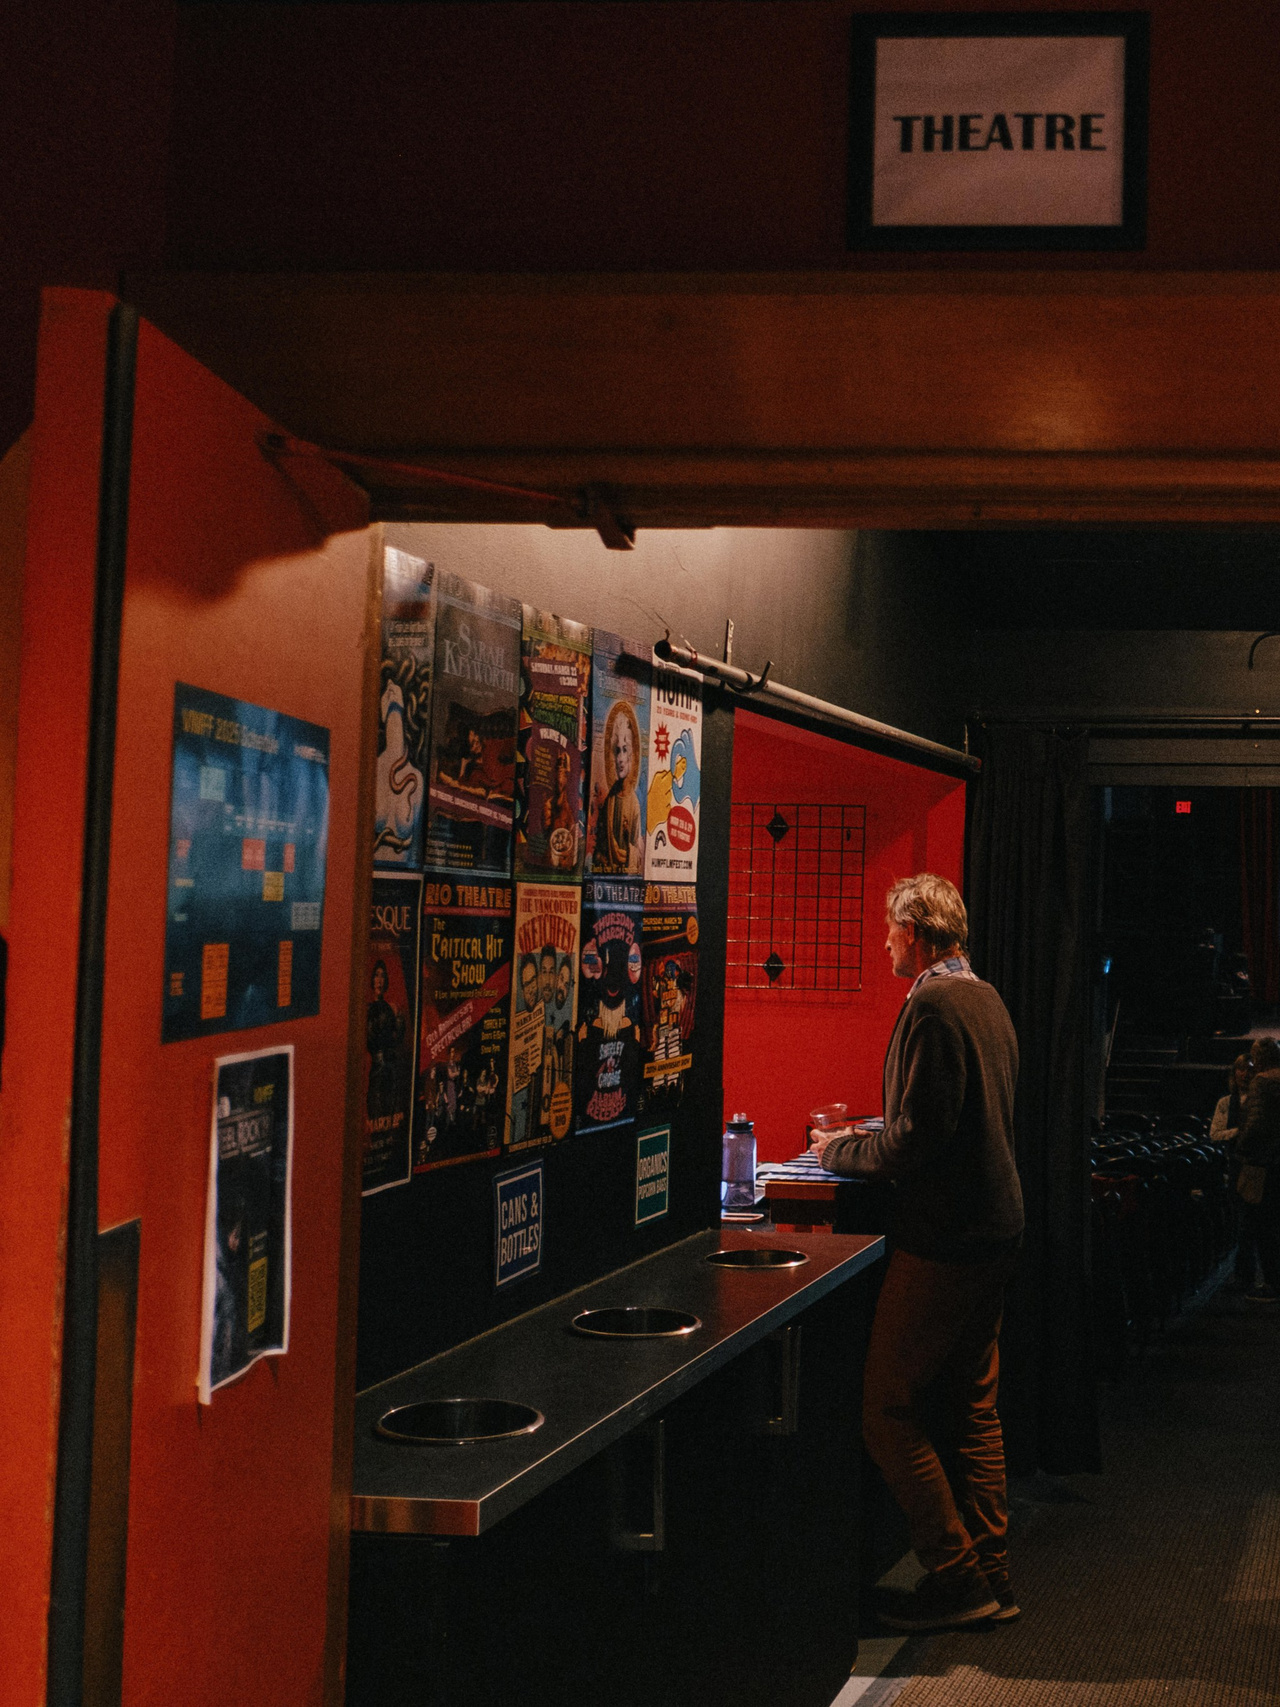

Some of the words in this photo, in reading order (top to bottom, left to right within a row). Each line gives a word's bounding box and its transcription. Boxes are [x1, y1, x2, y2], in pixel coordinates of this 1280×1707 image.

[892, 113, 1107, 153] THEATRE
[457, 622, 505, 670] SARAH
[443, 639, 515, 693] KEYWORTH
[425, 882, 453, 906] RIO
[455, 885, 513, 909] THEATRE
[534, 898, 579, 915] VANCOUVER
[431, 933, 484, 963] CRITICAL
[485, 933, 504, 963] HIT
[451, 960, 487, 989] SHOW
[639, 1150, 668, 1181] ORGANICS
[501, 1193, 528, 1231] CANS
[530, 1191, 539, 1218] &
[500, 1222, 540, 1267] BOTTLES
